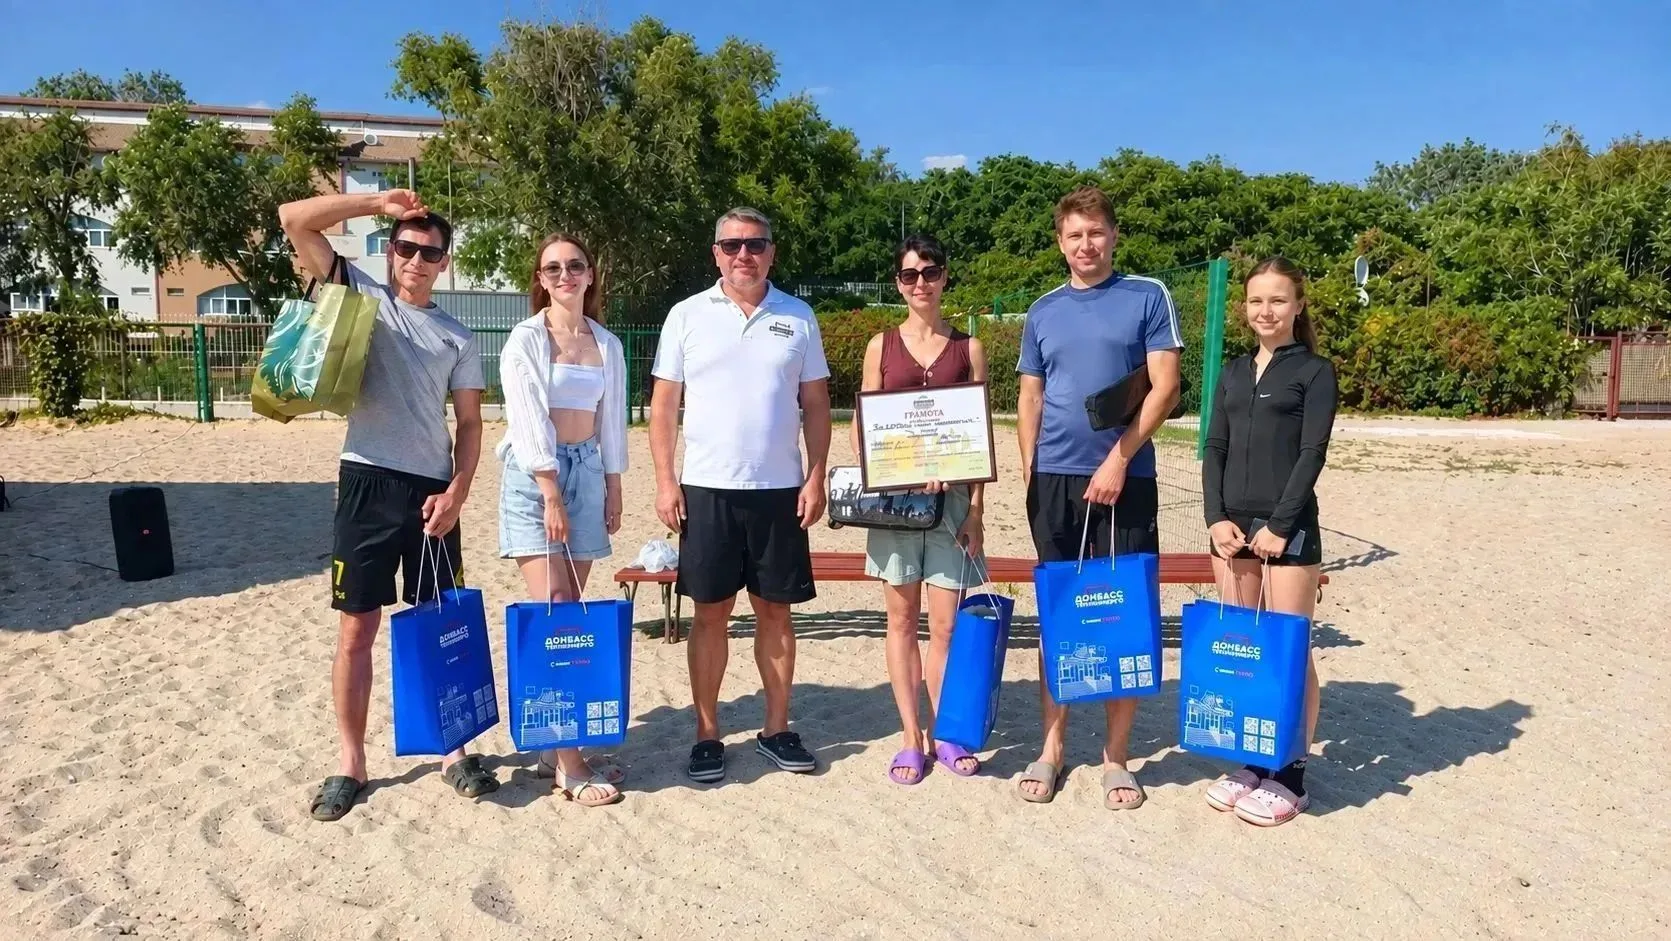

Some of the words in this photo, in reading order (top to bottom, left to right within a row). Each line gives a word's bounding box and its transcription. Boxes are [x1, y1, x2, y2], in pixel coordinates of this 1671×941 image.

[904, 409, 944, 420] ГРАМОТА
[334, 559, 345, 586] 7
[1075, 590, 1124, 603] ДОНБАСС
[544, 634, 595, 645] ДОНБАСС
[1212, 641, 1261, 655] ДОНБАСС
